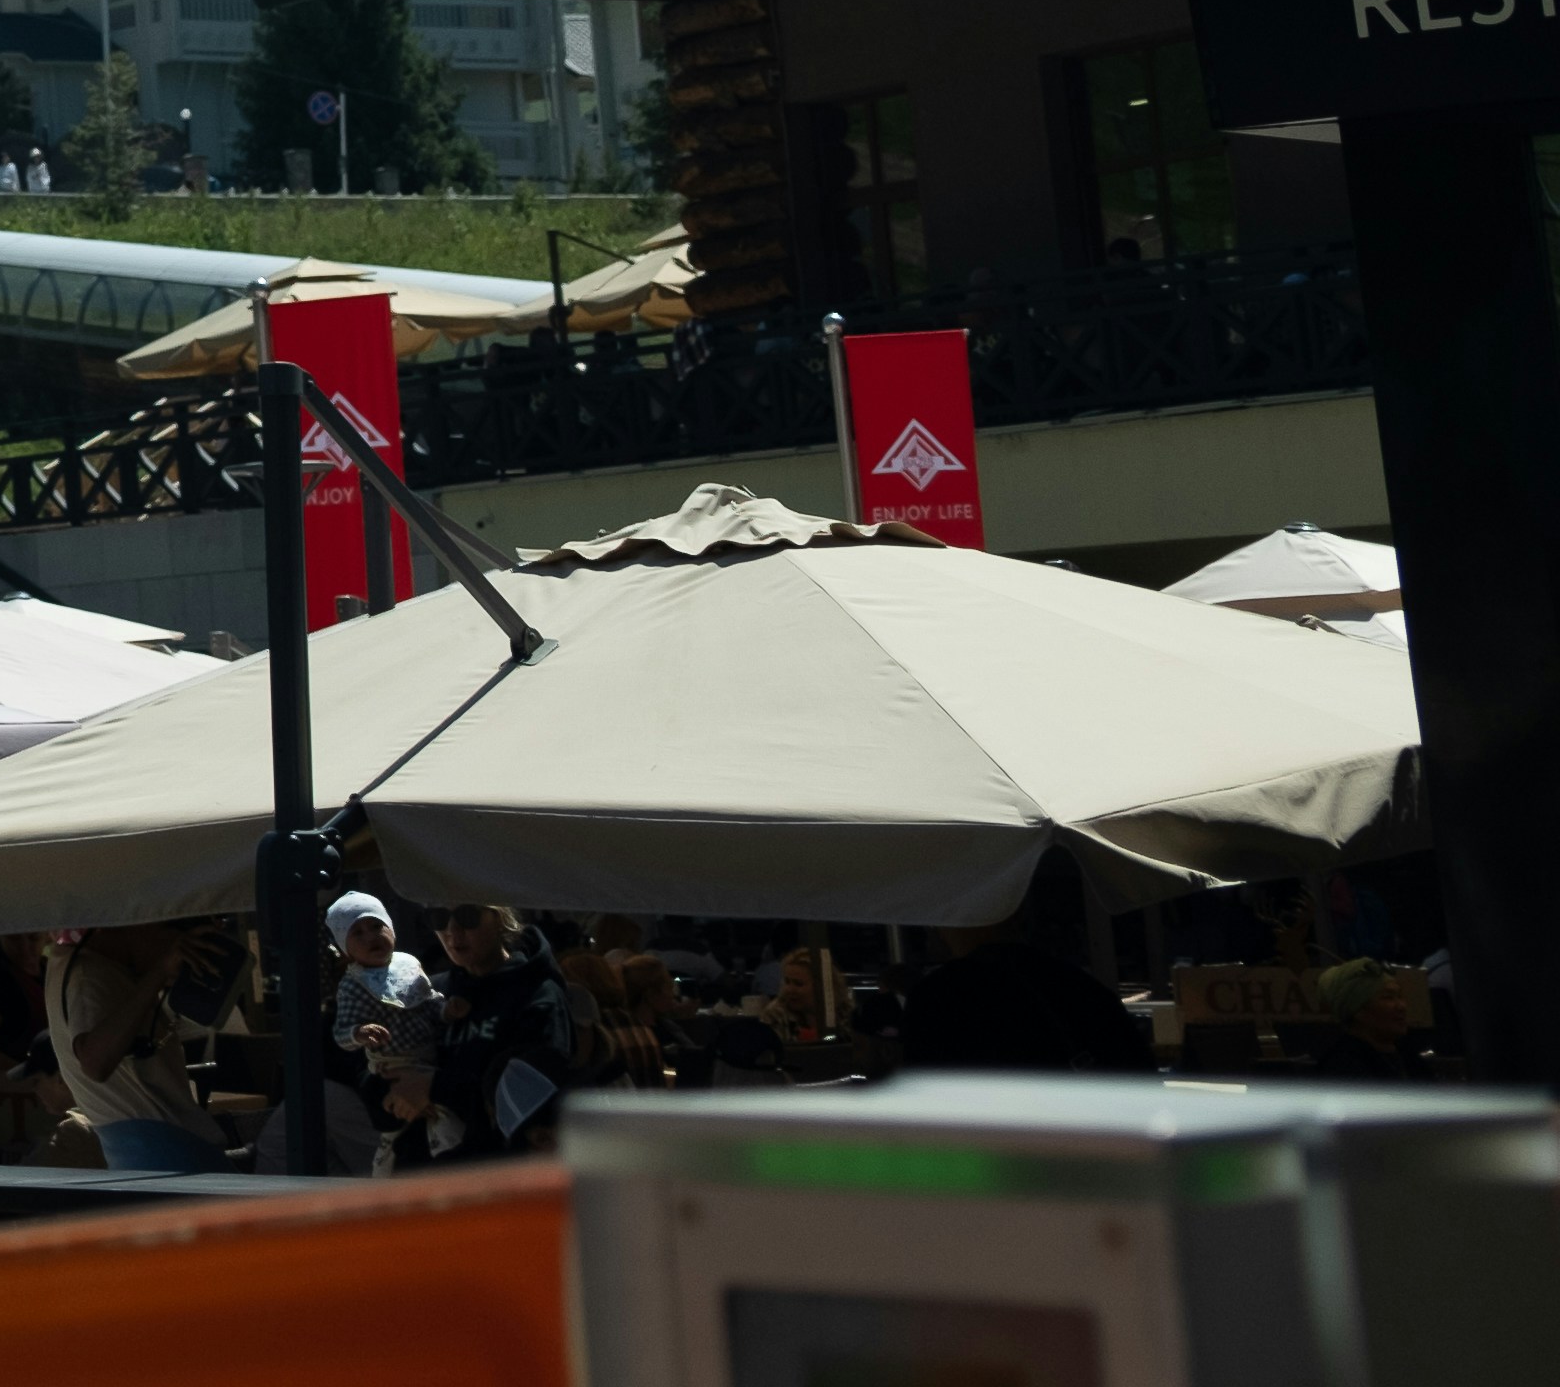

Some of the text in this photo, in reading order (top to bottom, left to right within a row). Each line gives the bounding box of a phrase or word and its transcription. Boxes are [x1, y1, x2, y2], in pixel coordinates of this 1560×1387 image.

[306, 486, 355, 506] NJOY
[871, 502, 974, 523] ENJOY LIFE
[1206, 978, 1332, 1015] CHA
